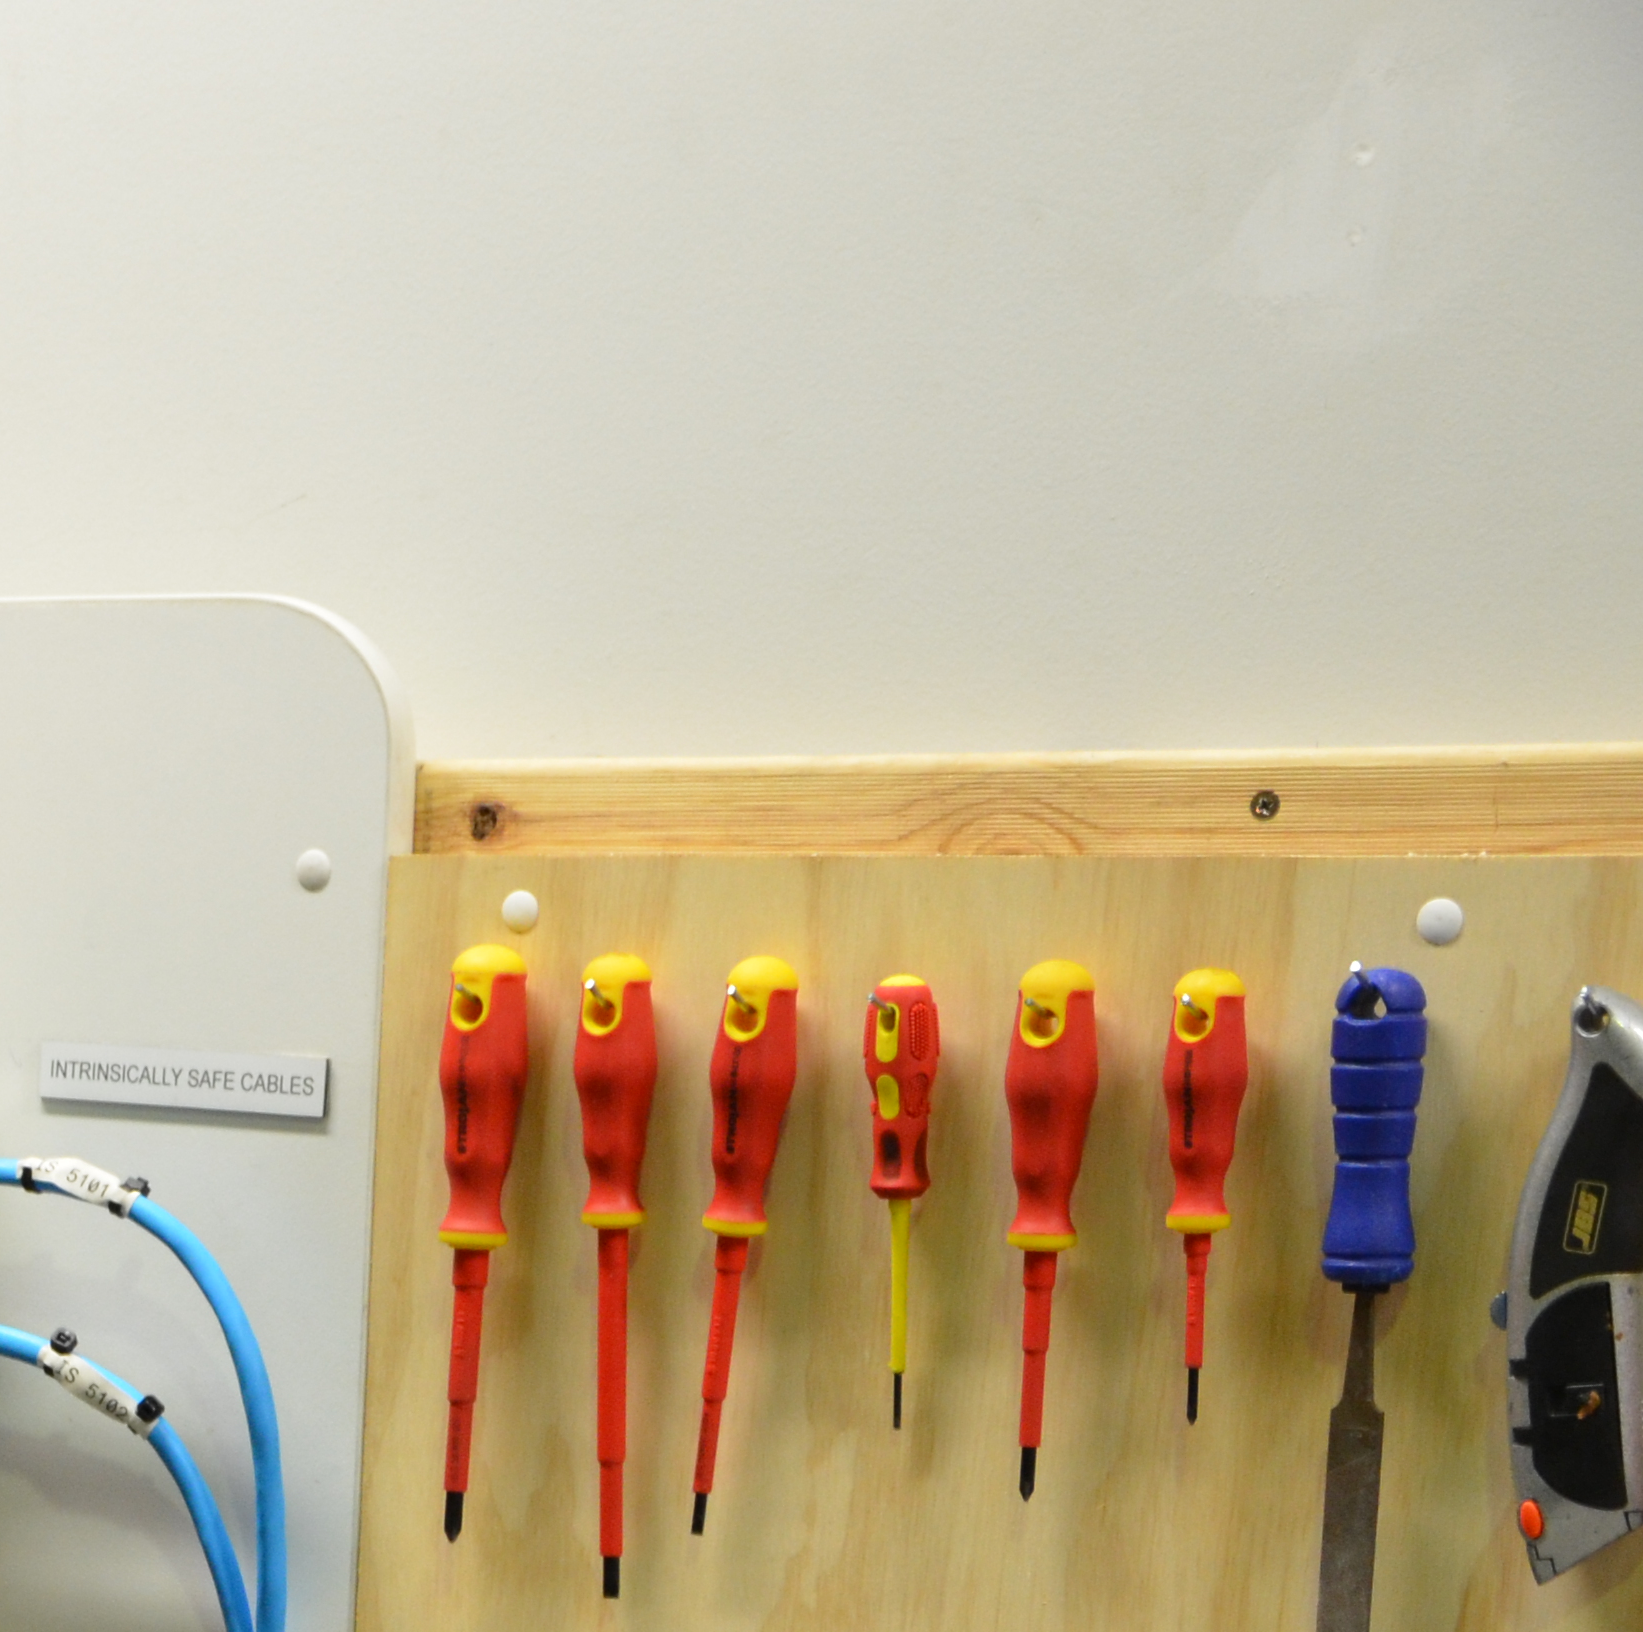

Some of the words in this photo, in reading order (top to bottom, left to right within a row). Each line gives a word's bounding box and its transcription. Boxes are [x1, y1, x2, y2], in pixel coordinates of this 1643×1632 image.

[50, 1059, 183, 1087] INTRINSICALLY
[187, 1069, 235, 1091] SAFE
[240, 1072, 315, 1096] CABLES
[66, 1168, 111, 1198] 5101
[85, 1383, 128, 1418] 5102
